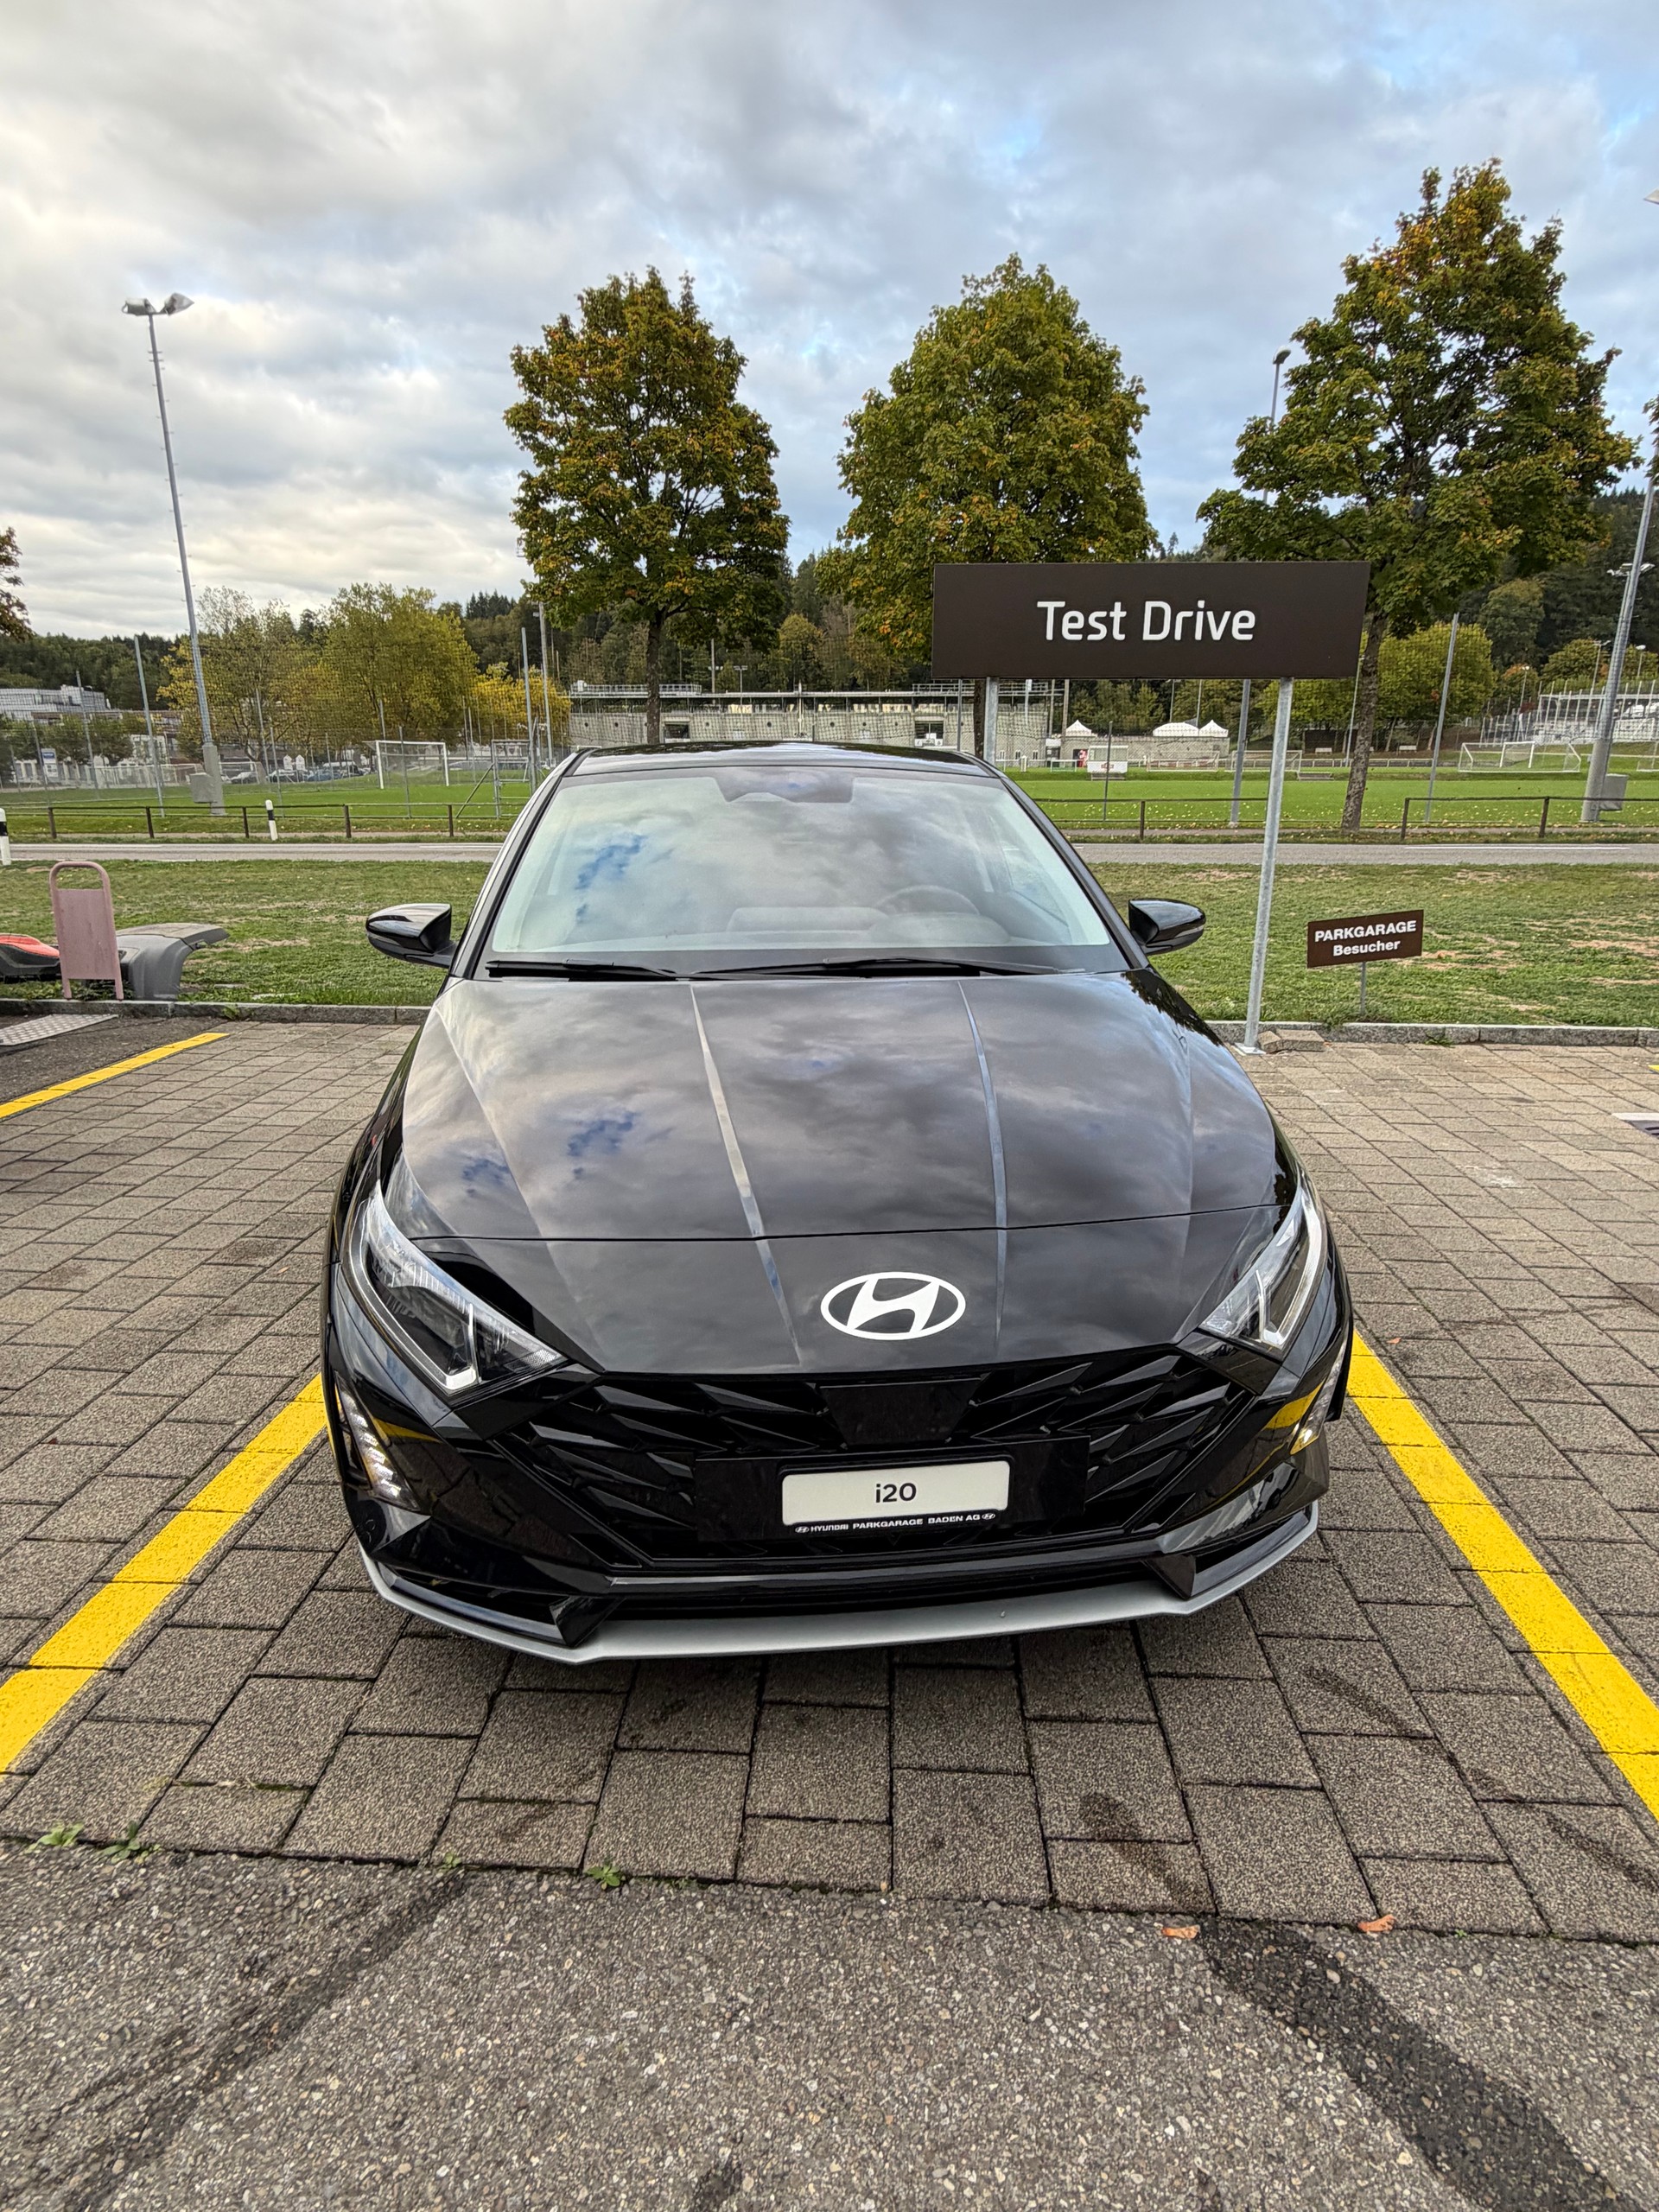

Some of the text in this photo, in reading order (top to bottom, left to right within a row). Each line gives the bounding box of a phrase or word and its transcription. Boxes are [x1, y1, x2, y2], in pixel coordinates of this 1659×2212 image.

[1037, 600, 1256, 641] Test Drive
[1314, 919, 1417, 943] PARKGARAGE
[1332, 940, 1402, 957] Besucher
[874, 1482, 918, 1503] i20
[810, 1523, 849, 1533] HYUNDAI
[852, 1518, 924, 1529] PARKGARAGE
[927, 1515, 963, 1524] BADEN
